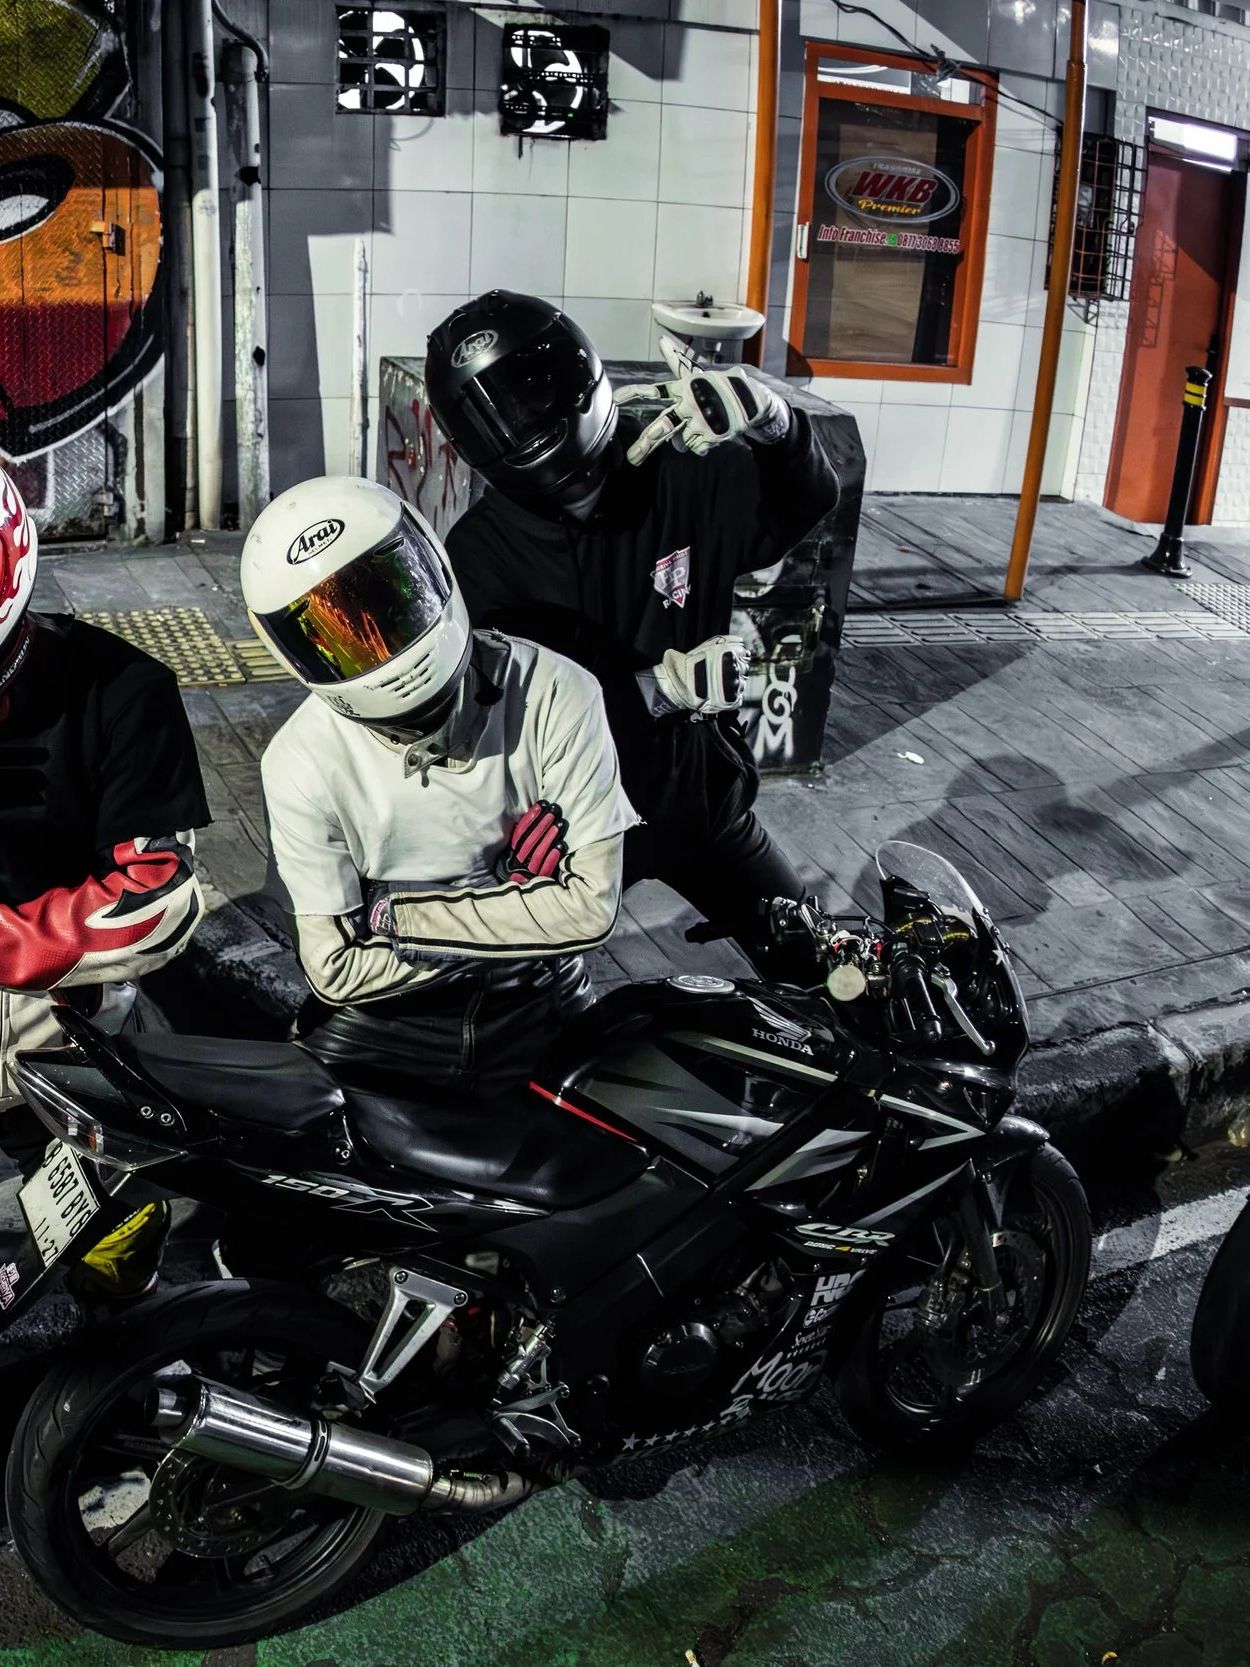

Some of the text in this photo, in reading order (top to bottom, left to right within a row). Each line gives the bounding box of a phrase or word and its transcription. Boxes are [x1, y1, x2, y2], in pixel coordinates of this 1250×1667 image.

[851, 171, 938, 203] WKB
[858, 198, 921, 215] Premier
[818, 224, 839, 241] Info
[839, 226, 886, 246] Franchise
[456, 331, 493, 366] Arai
[293, 519, 338, 563] Arai
[752, 1027, 814, 1056] HONDA
[43, 1142, 63, 1168] B
[48, 1156, 80, 1206] 6587
[795, 1222, 896, 1247] CBR
